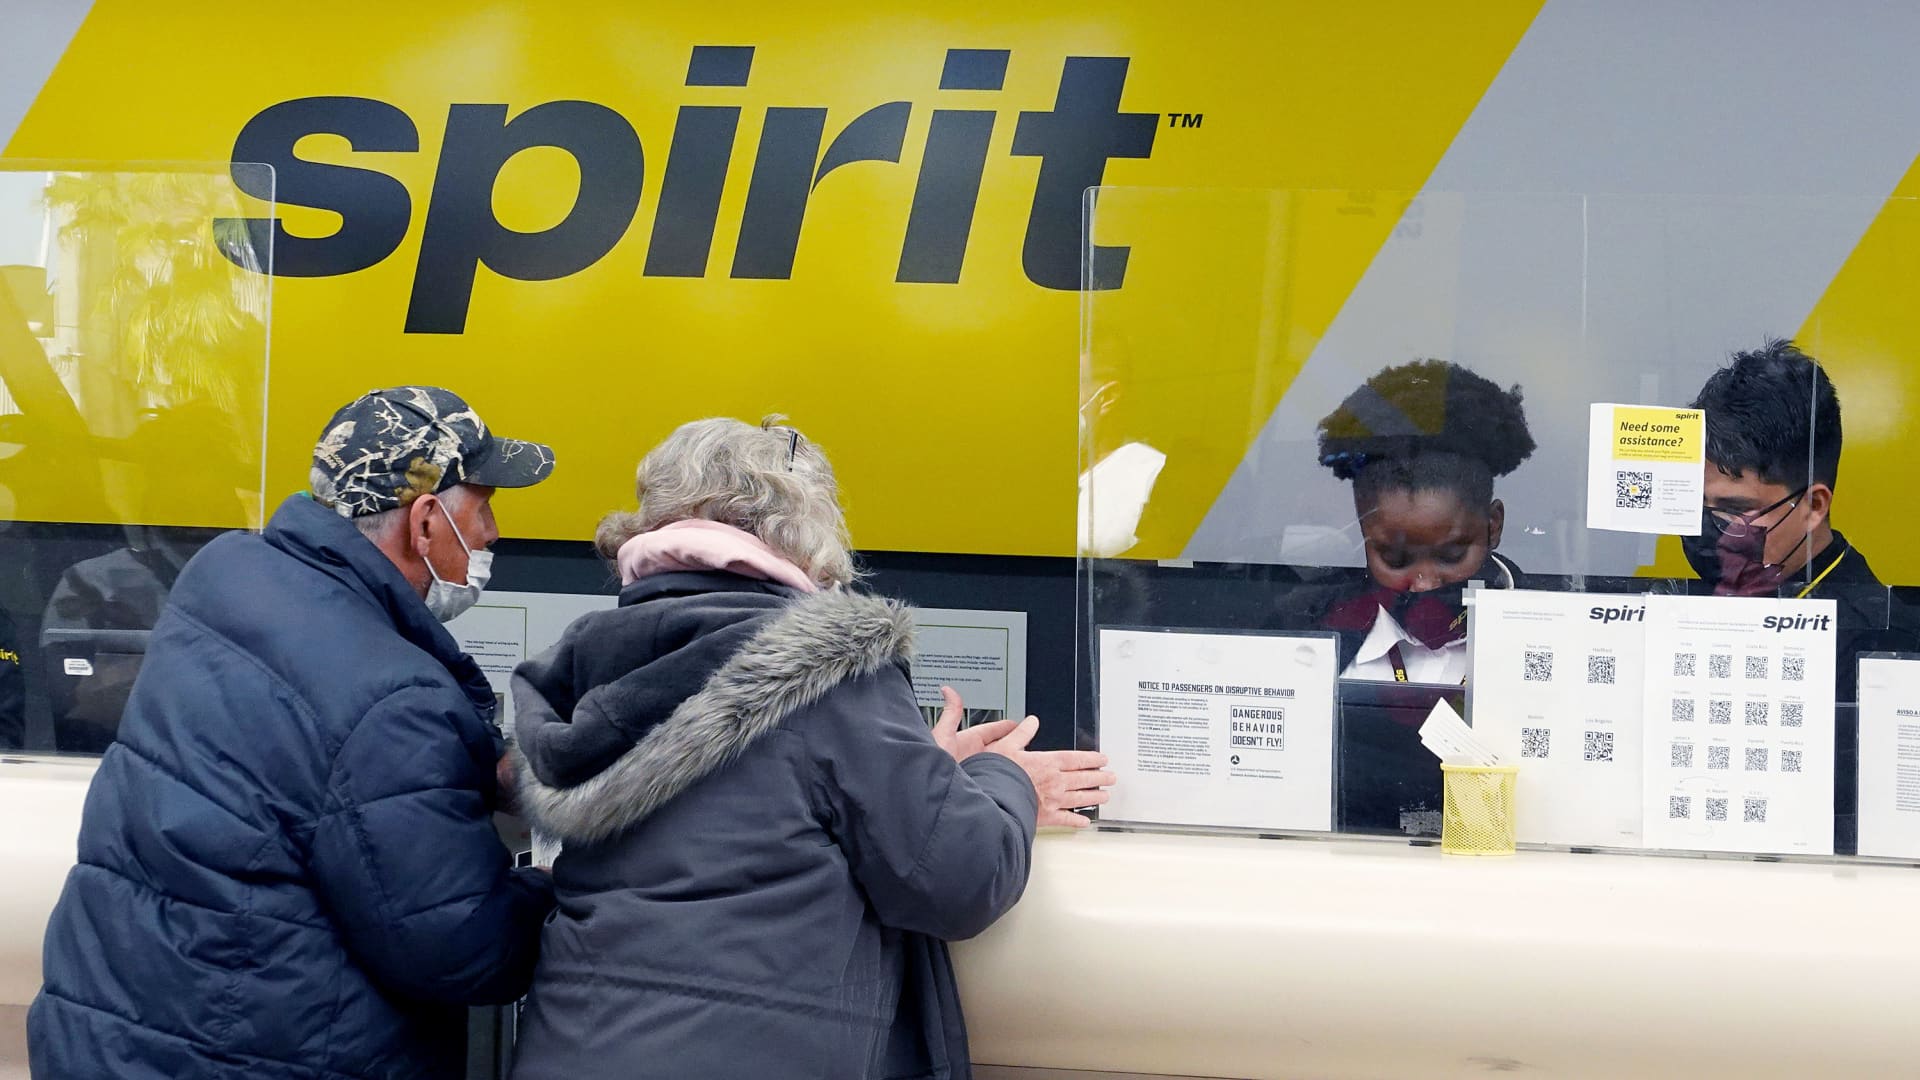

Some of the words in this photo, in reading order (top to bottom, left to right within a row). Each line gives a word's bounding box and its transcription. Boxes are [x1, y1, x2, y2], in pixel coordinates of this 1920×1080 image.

[214, 45, 1160, 334] spirit
[1675, 412, 1700, 421] spirit
[1620, 421, 1649, 432] Need
[1650, 424, 1680, 434] some
[1619, 434, 1684, 447] assistance?
[1589, 605, 1646, 624] spiri
[1762, 613, 1830, 633] spirit
[1138, 681, 1160, 691] NOTICE
[1161, 682, 1170, 691] TO
[1171, 683, 1213, 693] PASSENGERS
[1214, 685, 1224, 693] ON
[1225, 685, 1263, 696] DISRUPTIVE
[1263, 688, 1295, 697] BEHAVIOR
[1232, 708, 1283, 721] DANGEROUS
[1232, 722, 1282, 734] BEHAVIOR
[1232, 735, 1263, 746] DOESN'T
[1266, 737, 1282, 748] FLY!
